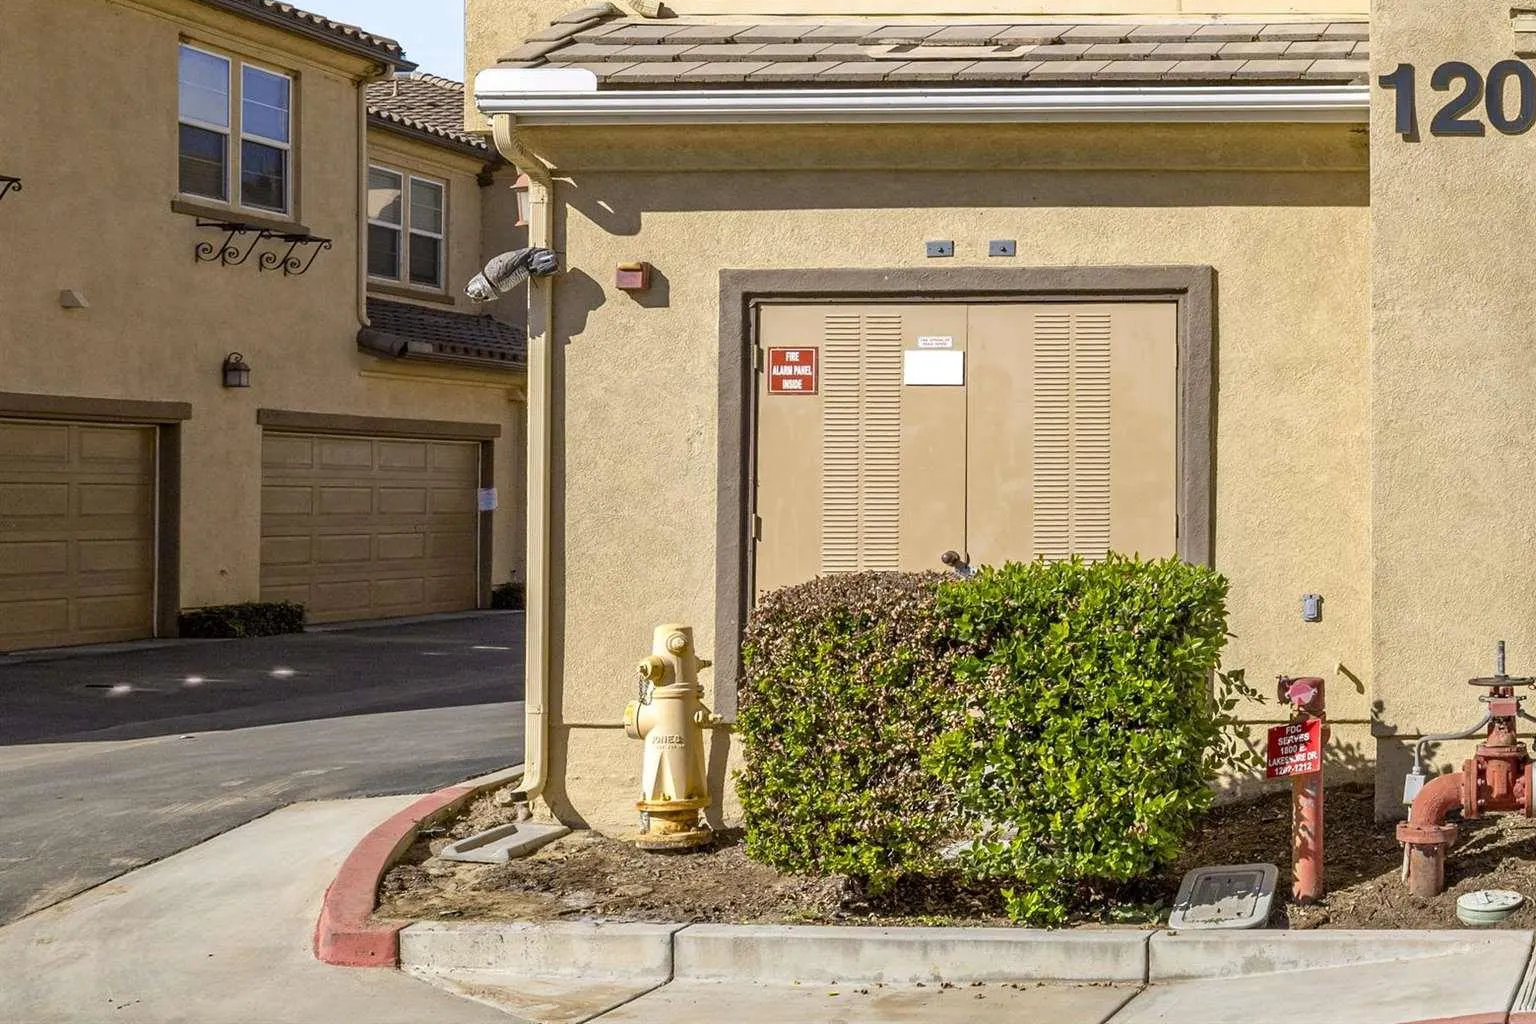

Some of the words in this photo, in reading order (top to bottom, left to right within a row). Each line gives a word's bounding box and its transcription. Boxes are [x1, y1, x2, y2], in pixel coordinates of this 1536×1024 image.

[785, 351, 800, 362] FIRE
[772, 365, 793, 376] ALARM
[793, 365, 812, 376] PANEL
[782, 379, 803, 390] INSIDE
[1286, 725, 1302, 735] FDC
[1278, 733, 1310, 746] SERVES
